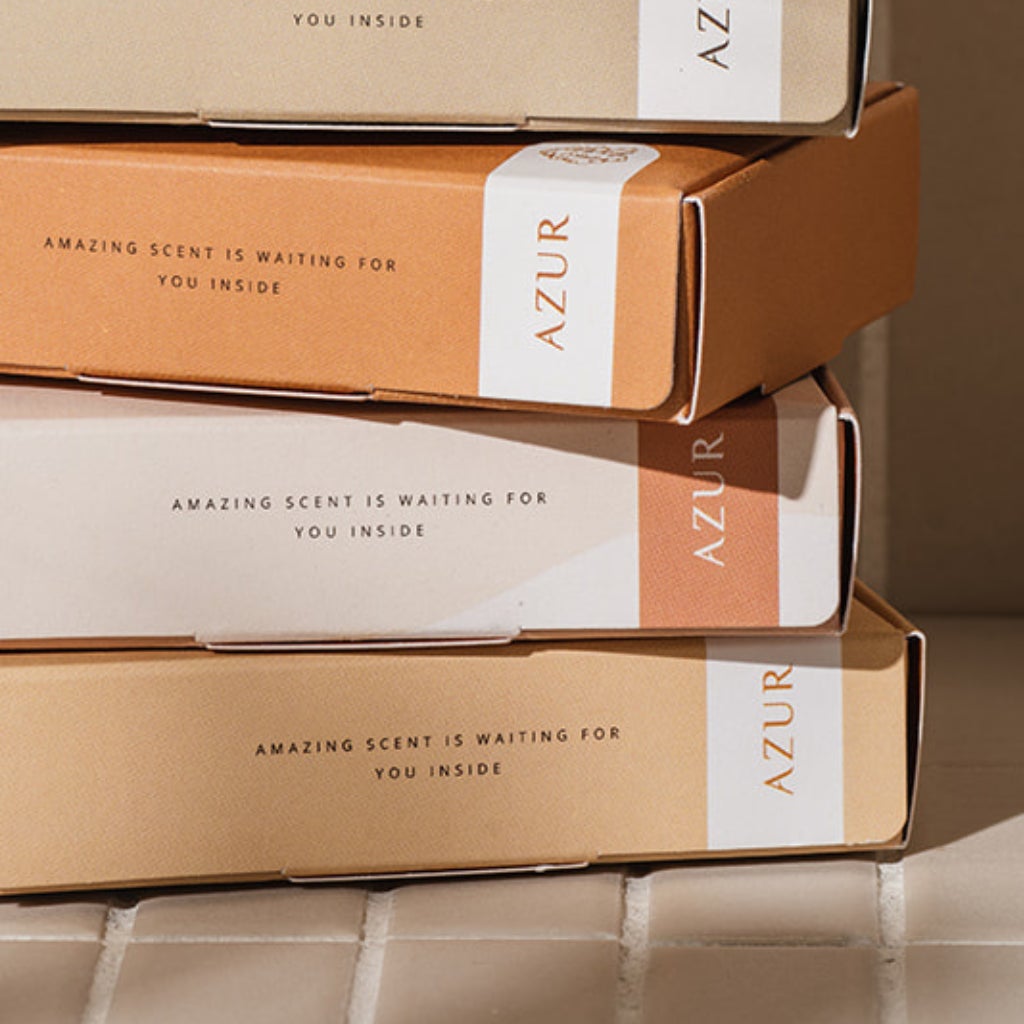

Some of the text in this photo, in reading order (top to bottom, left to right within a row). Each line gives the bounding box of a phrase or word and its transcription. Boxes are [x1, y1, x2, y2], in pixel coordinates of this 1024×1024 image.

[292, 12, 424, 29] YOU INSIDE
[43, 236, 396, 273] AMAZING SCENT IS WAITING FOR
[157, 274, 280, 295] YOU INSIDE
[534, 213, 569, 352] AZUR
[171, 491, 547, 512] AMAZING SCENT IS WAITING FOR
[691, 431, 725, 568] AZUR
[294, 523, 425, 540] YOU INSIDE
[254, 725, 620, 757] AMAZING SCENT IS WAITING FOR
[762, 663, 795, 796] AZUR
[374, 761, 501, 781] YOU INSIDE
